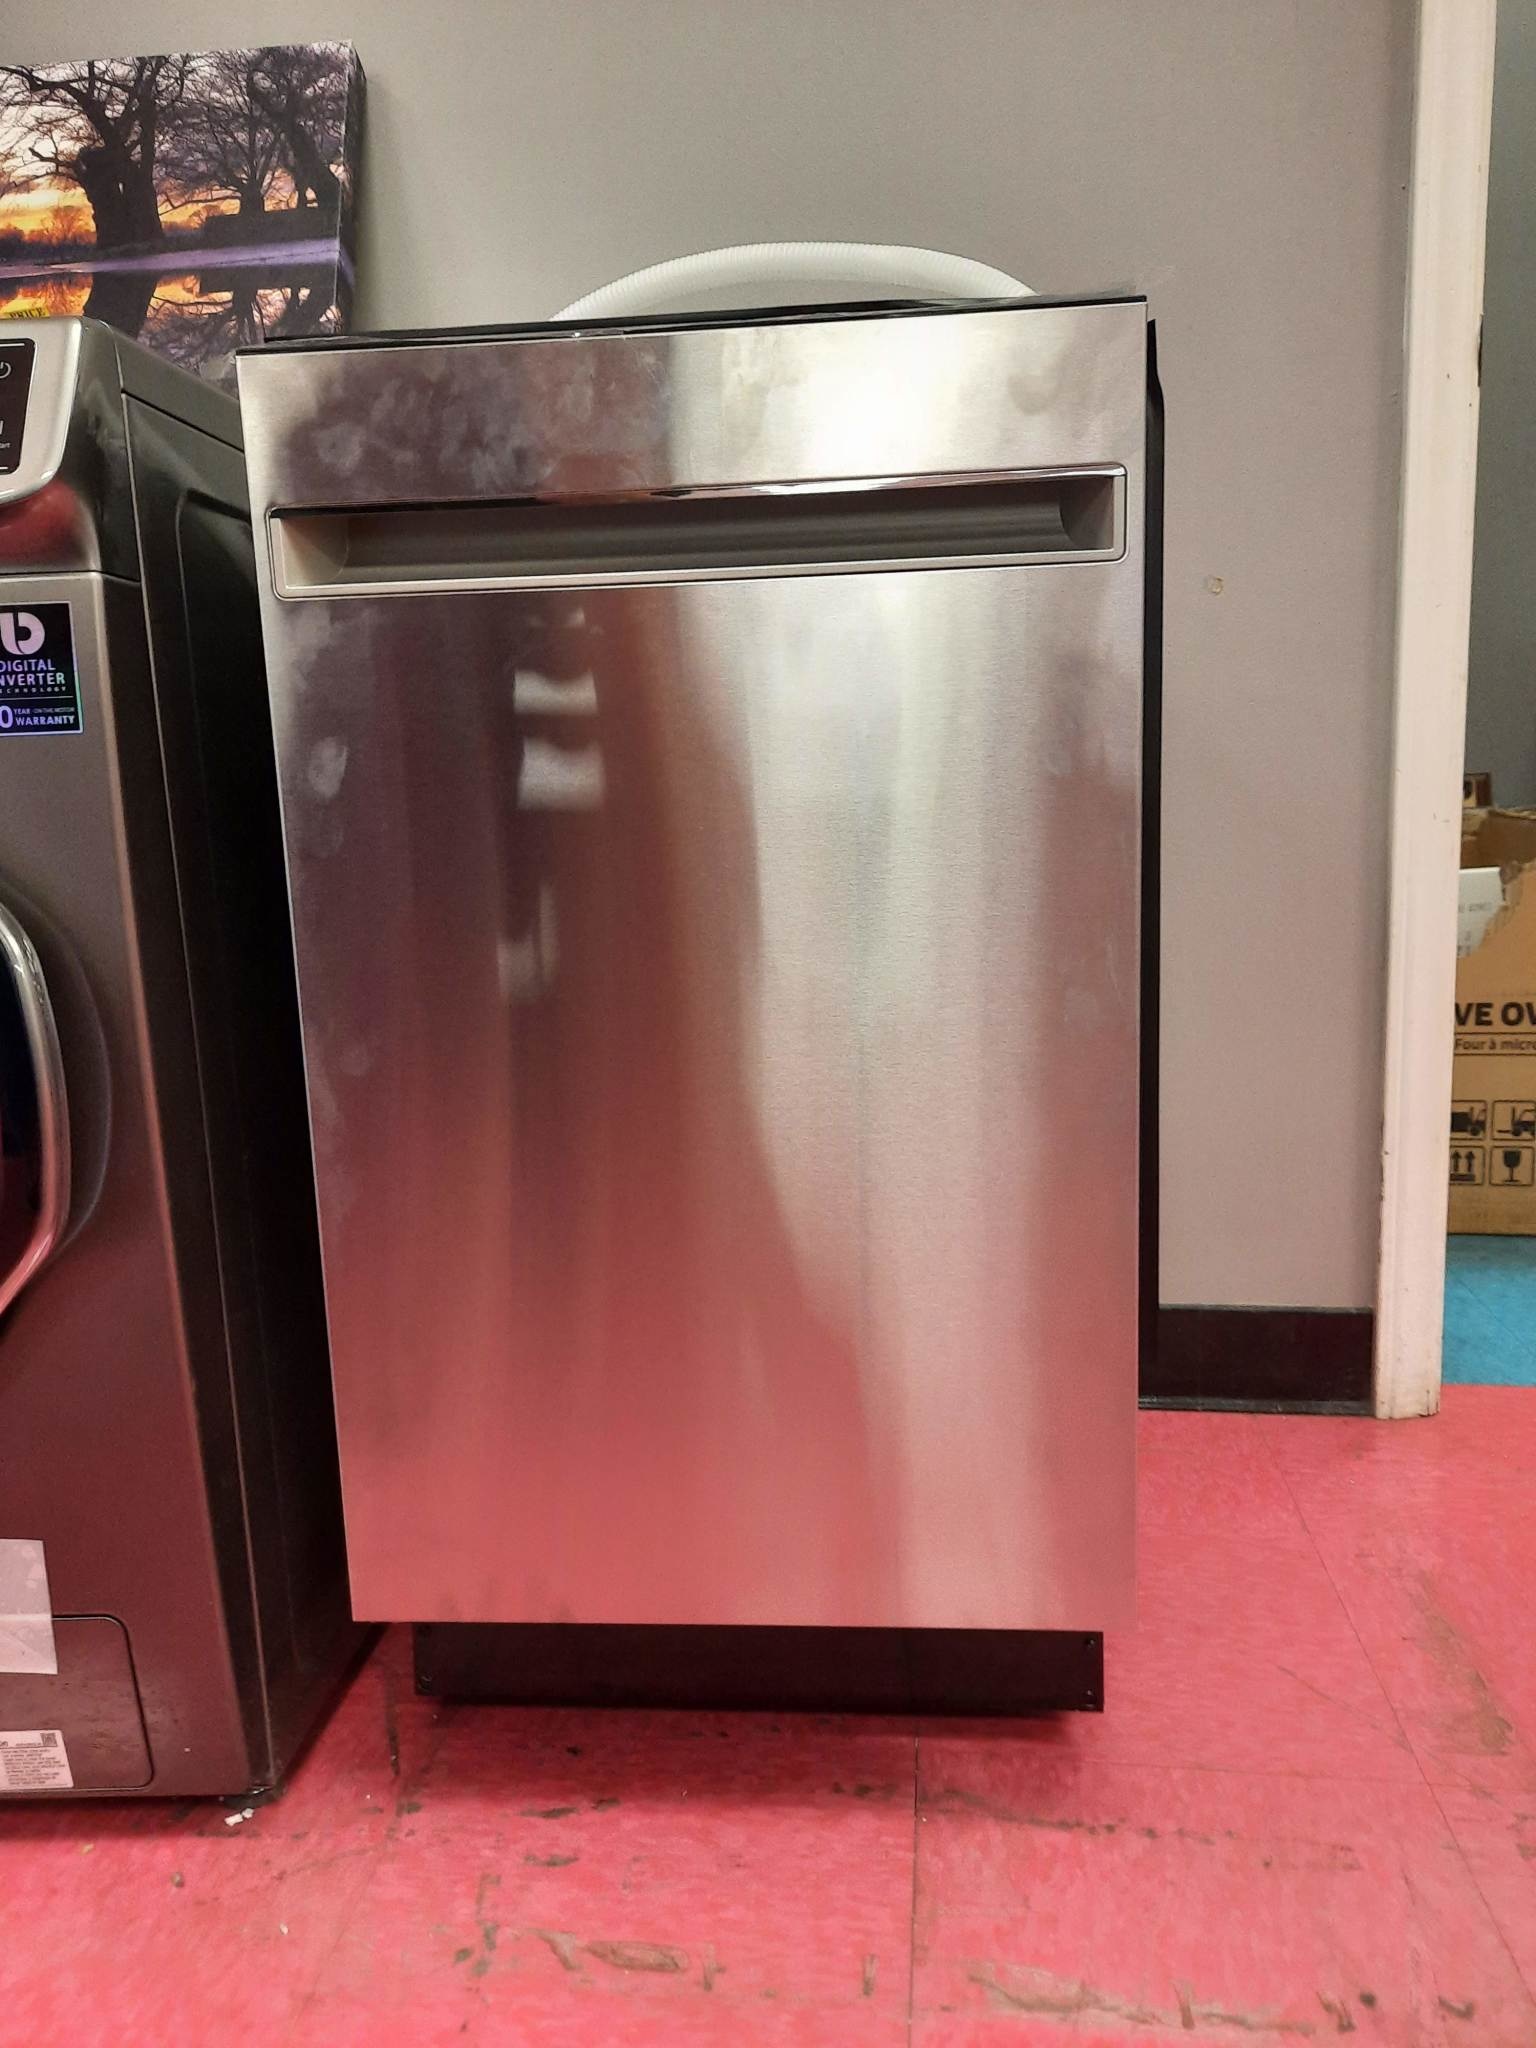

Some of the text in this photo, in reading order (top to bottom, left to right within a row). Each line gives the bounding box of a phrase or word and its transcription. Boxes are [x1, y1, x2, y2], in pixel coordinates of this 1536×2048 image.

[0, 659, 56, 672] DIGITAL
[15, 715, 75, 726] WARRANTY
[1455, 1002, 1493, 1026] VE
[1455, 1038, 1487, 1050] Four
